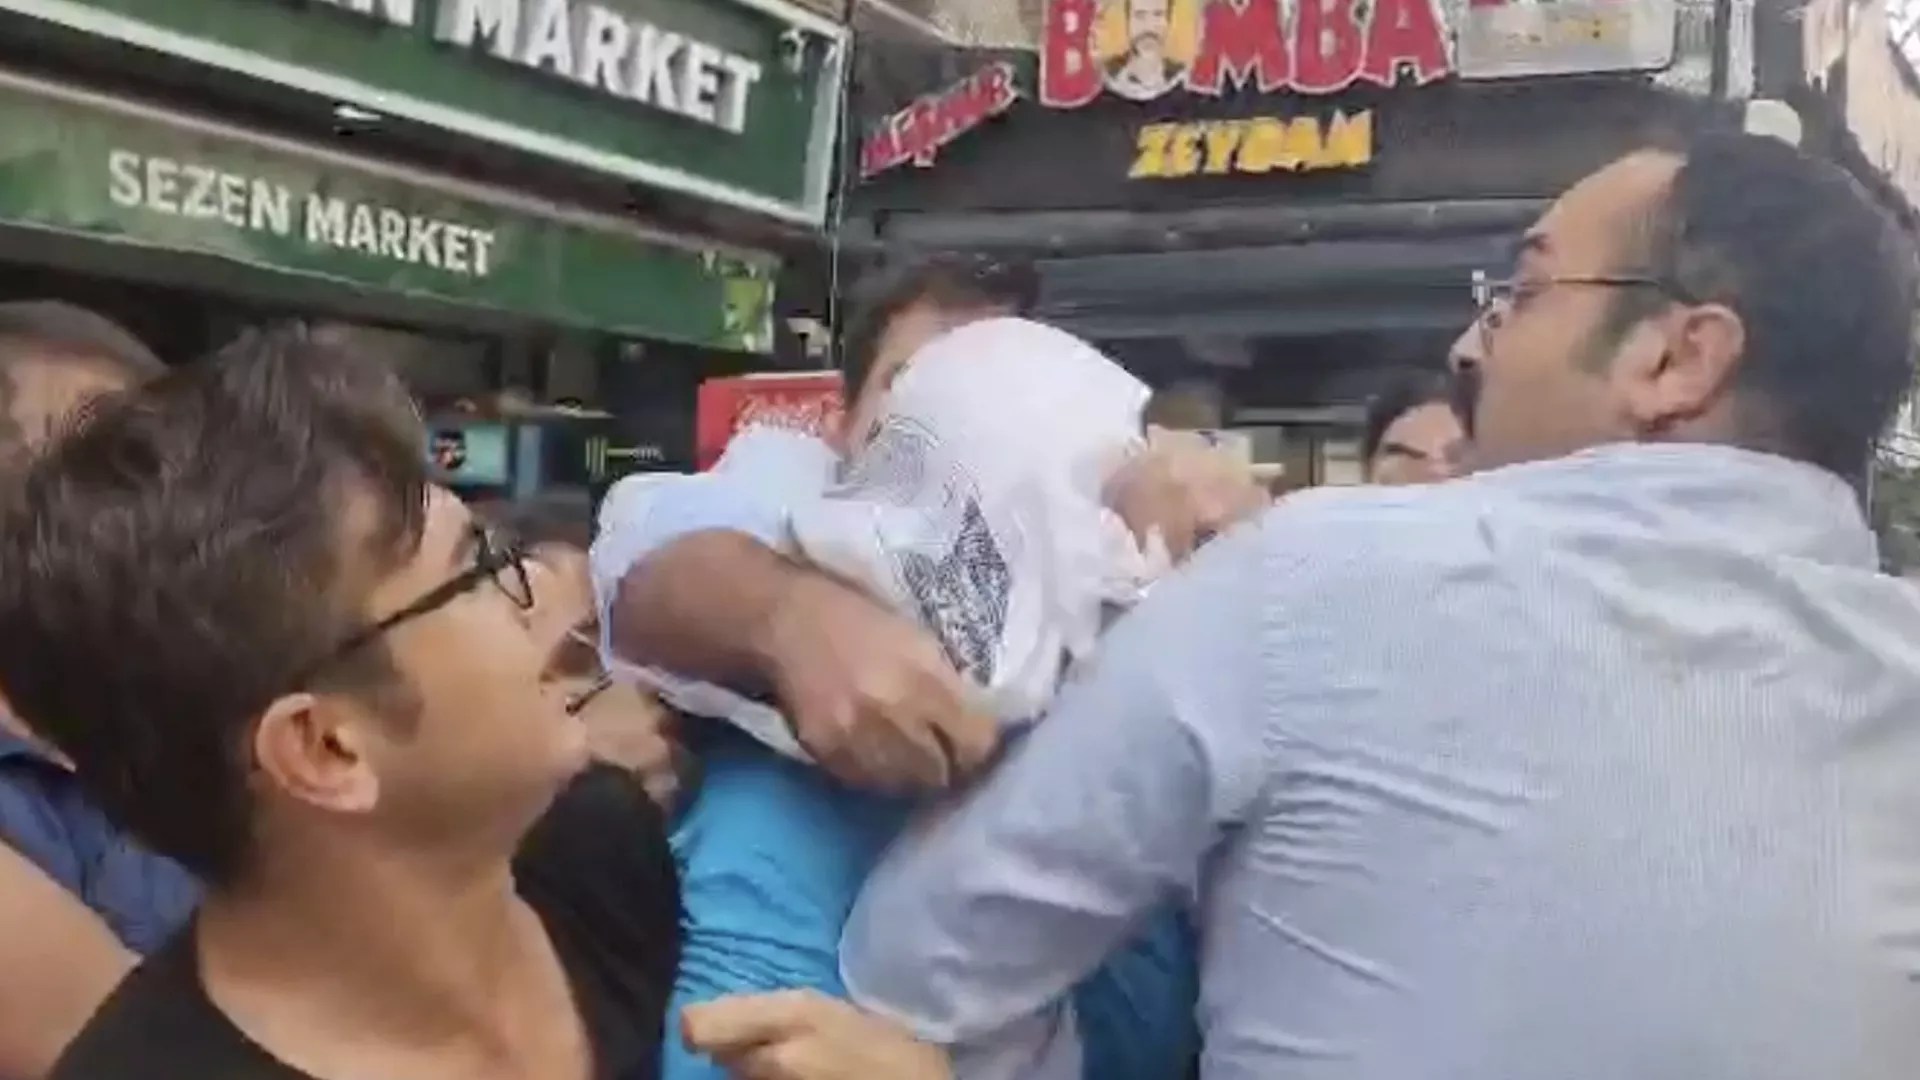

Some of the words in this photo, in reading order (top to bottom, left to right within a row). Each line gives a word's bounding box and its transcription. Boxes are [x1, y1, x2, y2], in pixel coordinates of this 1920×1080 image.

[434, 0, 761, 134] MARKET
[109, 149, 290, 236] SEZEN
[306, 193, 494, 276] MARKET
